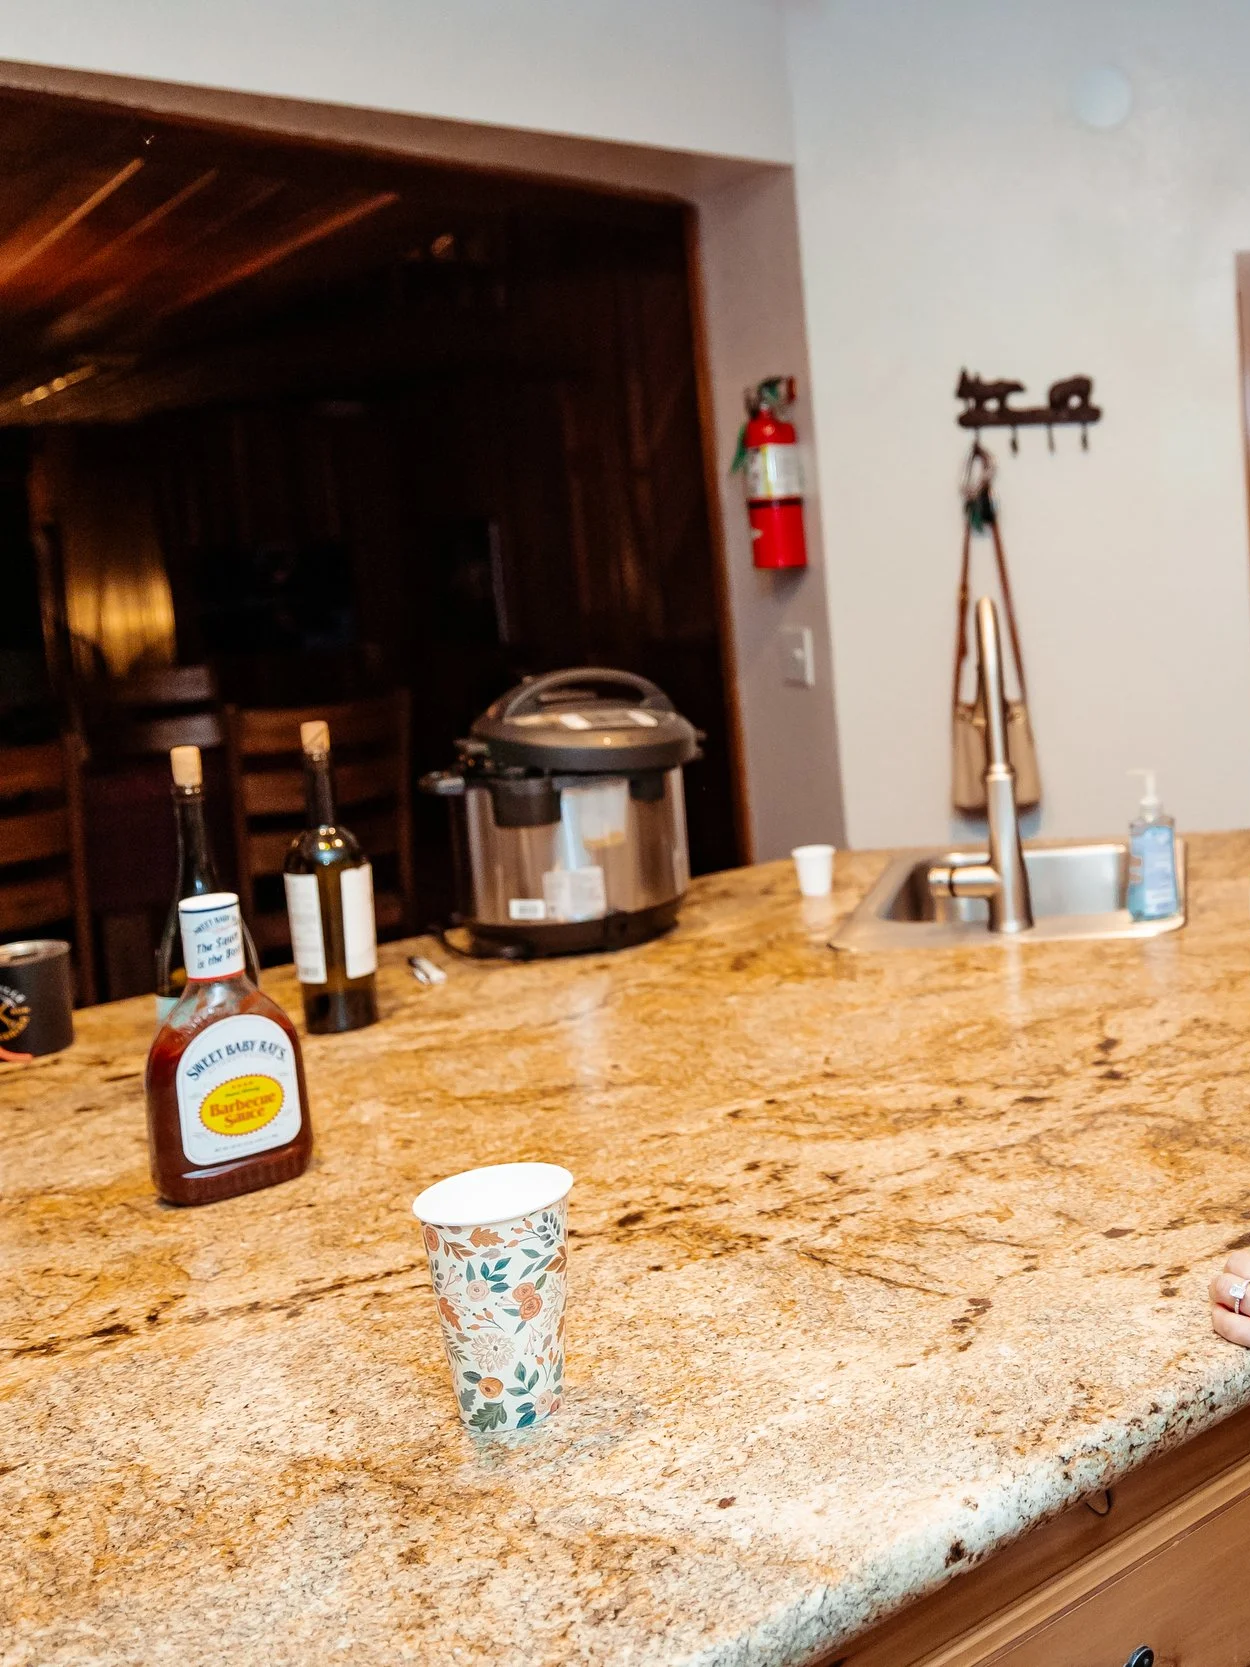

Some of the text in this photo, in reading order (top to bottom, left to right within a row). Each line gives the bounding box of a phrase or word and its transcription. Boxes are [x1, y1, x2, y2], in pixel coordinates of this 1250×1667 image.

[186, 1048, 224, 1081] SWEET
[225, 1040, 257, 1056] BABY
[210, 1092, 277, 1117] Barbecue
[224, 1107, 266, 1128] Sauce
